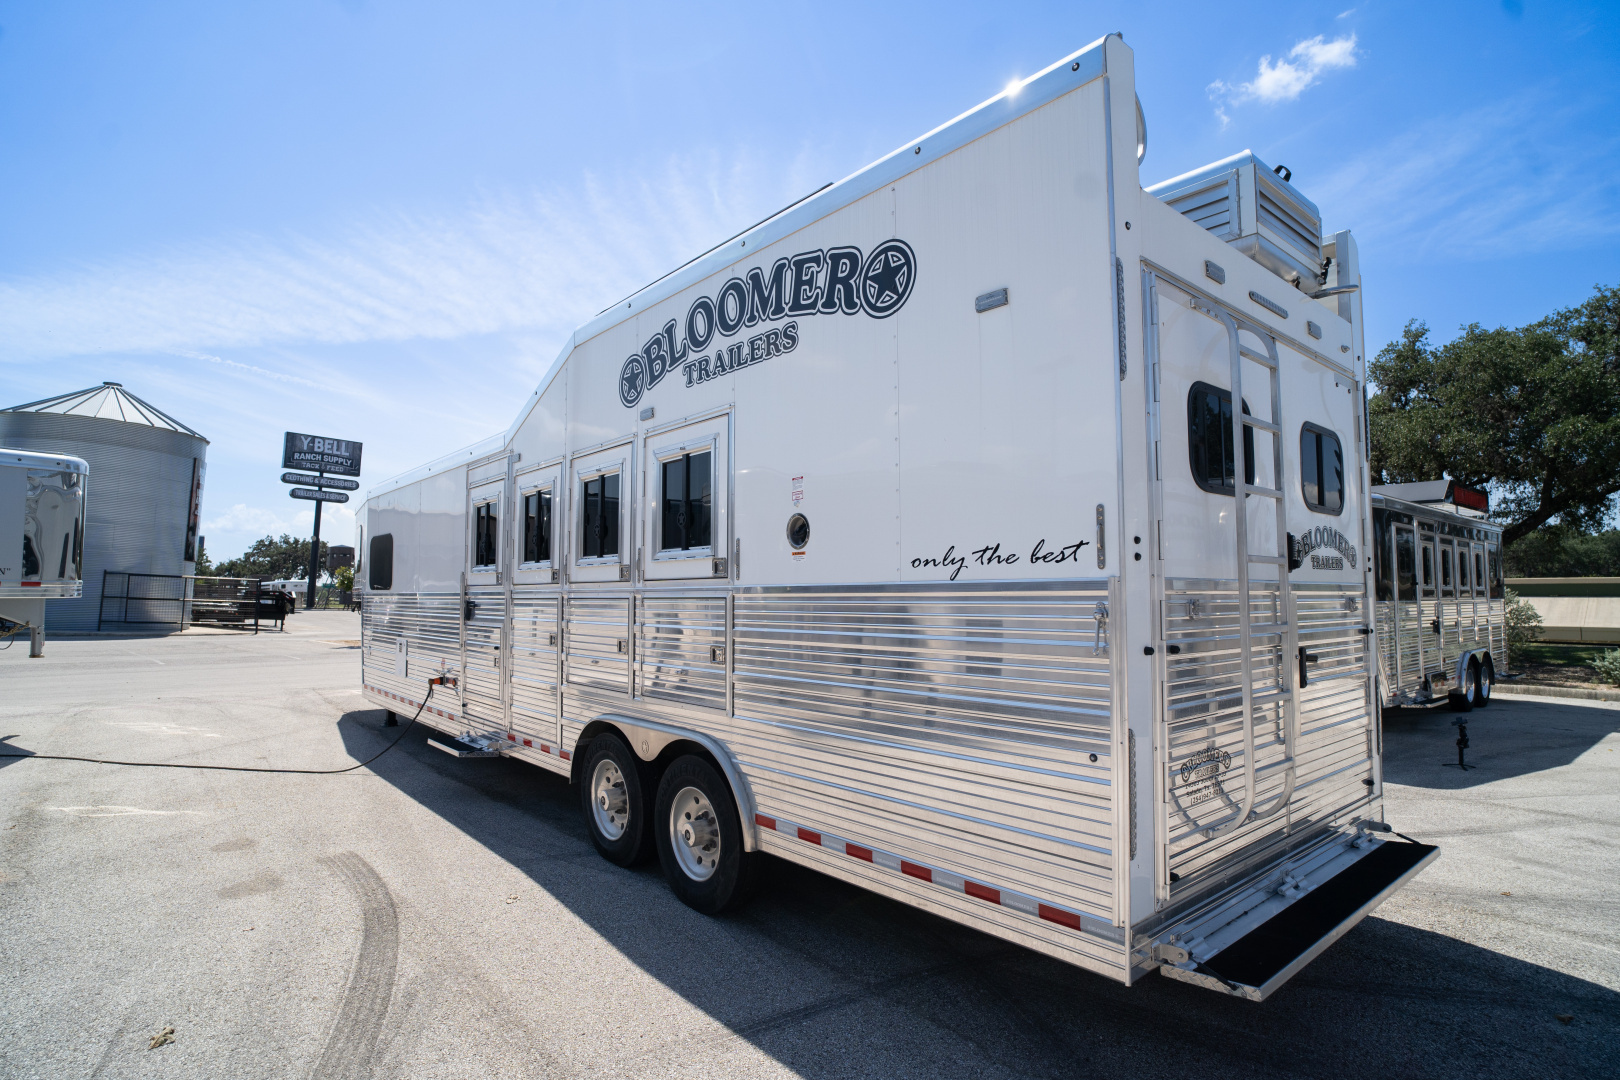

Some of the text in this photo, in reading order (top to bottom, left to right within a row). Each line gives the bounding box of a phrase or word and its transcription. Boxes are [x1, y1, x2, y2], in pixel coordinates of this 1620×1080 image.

[642, 246, 863, 390] BLOOMER
[682, 320, 799, 389] TRAILERS
[301, 436, 349, 456] Y-BELL
[294, 452, 352, 467] RANCH SUPPLY
[326, 464, 344, 472] FEED
[286, 474, 357, 488] CLOTHING & ACCESSORIES
[312, 490, 325, 499] SALES
[1301, 525, 1350, 563] BLOOMER
[910, 538, 1090, 581] only the best
[1310, 554, 1344, 571] TRAILERS
